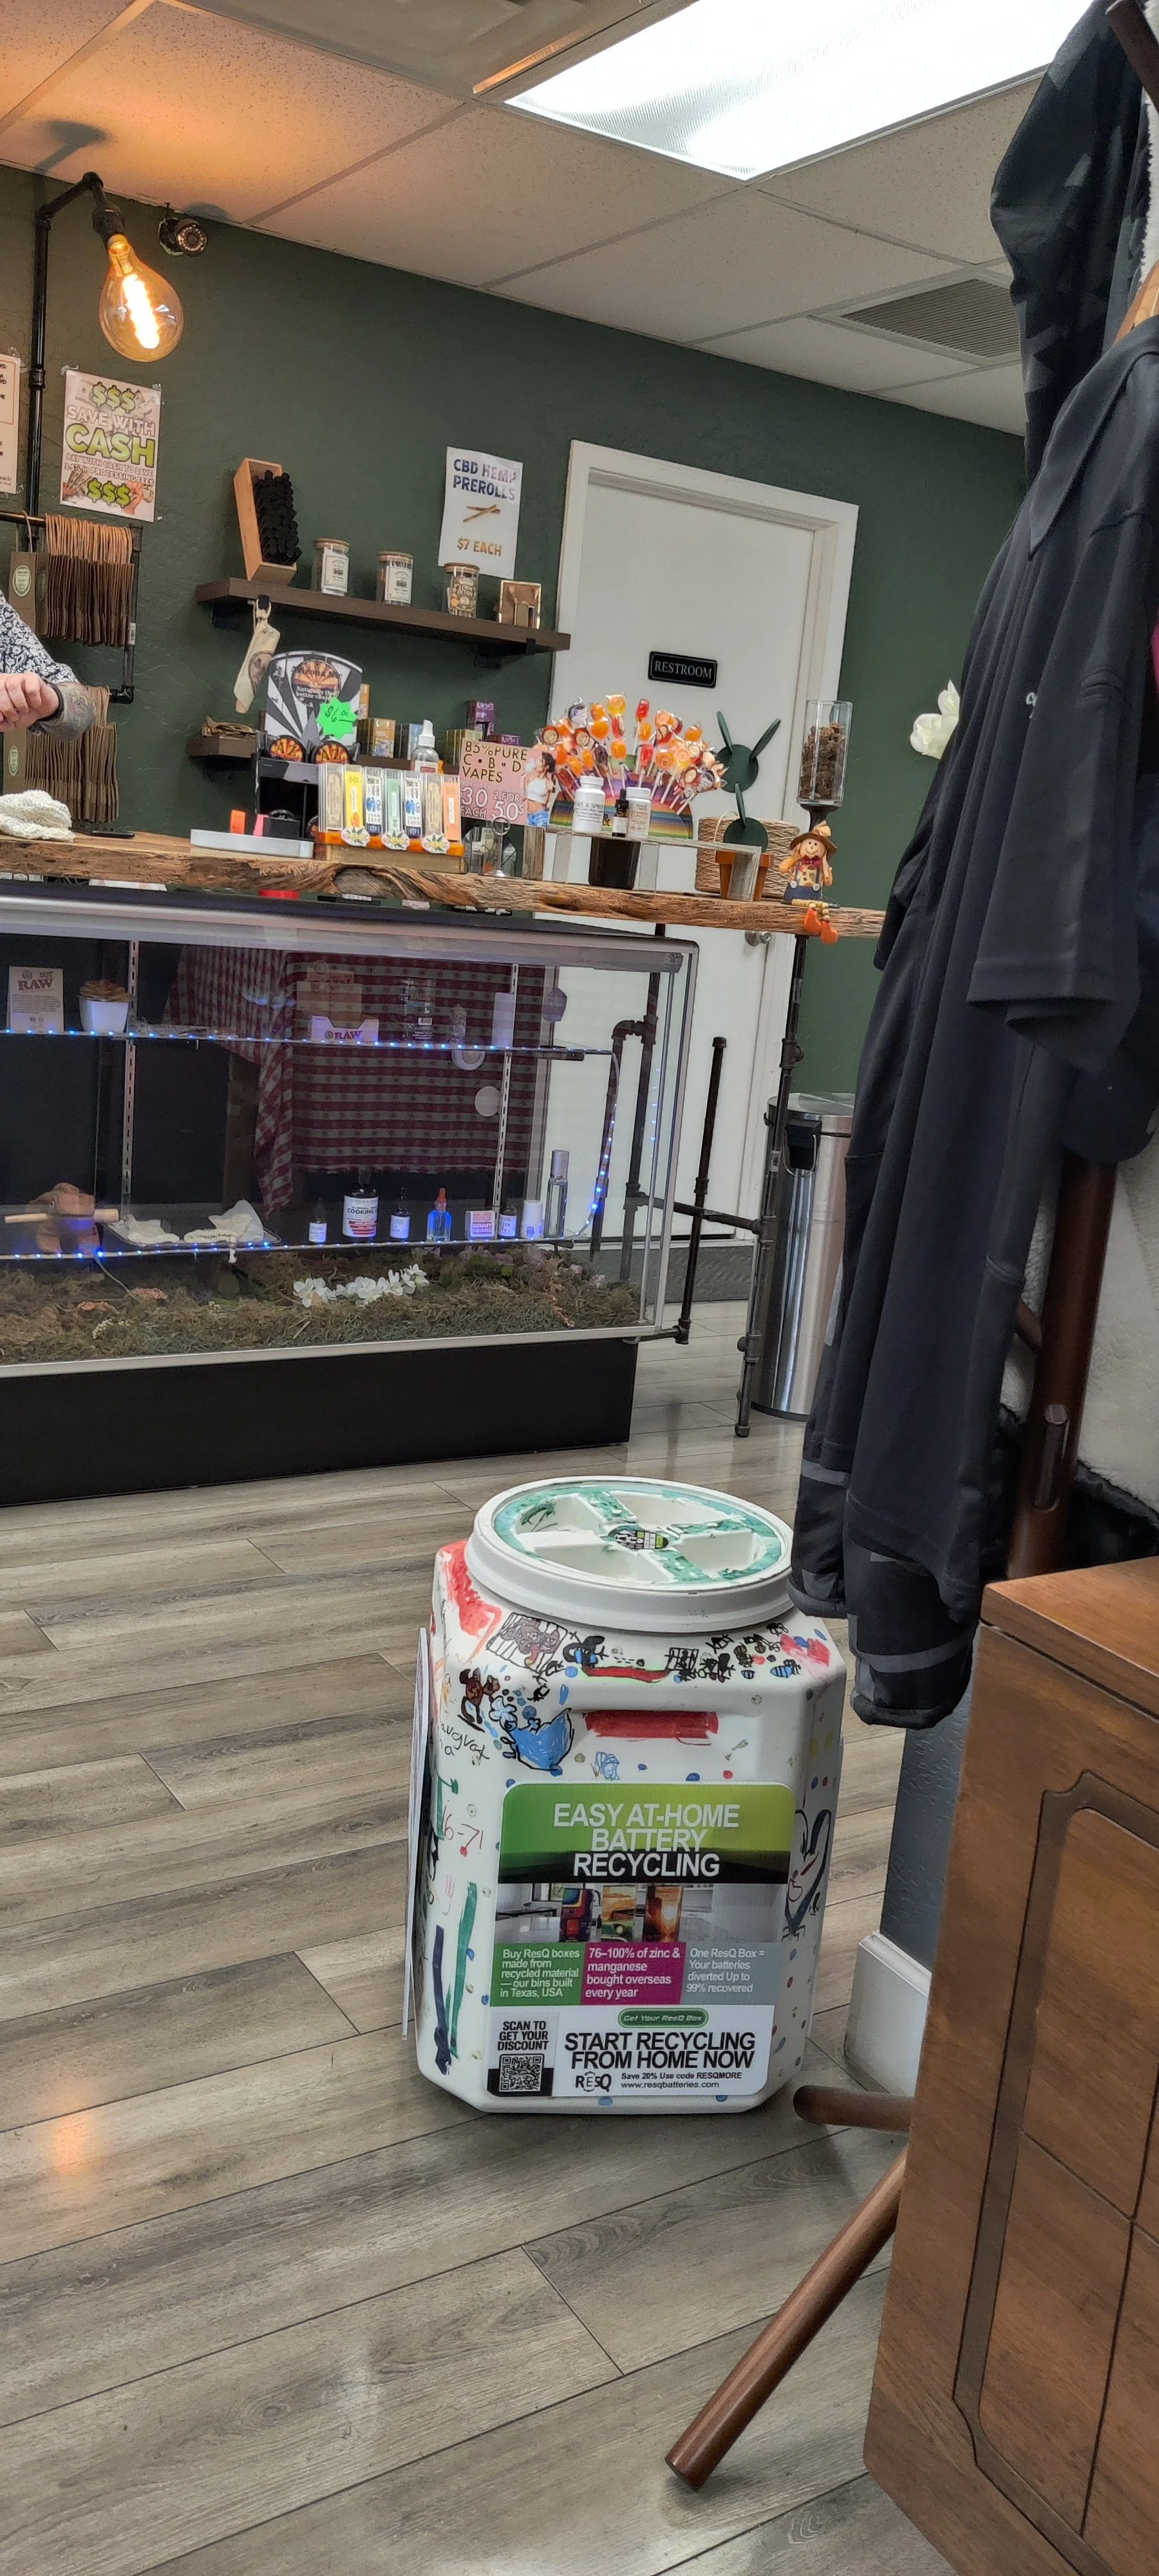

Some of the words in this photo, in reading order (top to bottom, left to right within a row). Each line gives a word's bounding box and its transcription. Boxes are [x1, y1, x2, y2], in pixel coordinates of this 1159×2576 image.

[92, 382, 135, 413] $$$
[66, 405, 108, 426] SAVE
[112, 414, 155, 437] WITH
[66, 423, 155, 468] CASH
[66, 453, 81, 462] PAY
[80, 456, 102, 467] WITH
[103, 460, 125, 471] CASH
[134, 467, 153, 477] SAVE
[90, 467, 137, 482] PROCESSING
[137, 477, 154, 486] FEES
[453, 459, 478, 475] CBD
[482, 464, 517, 484] HEMP
[87, 478, 131, 508] $$$
[453, 475, 515, 501] PREROLLS
[457, 536, 470, 550] $7
[473, 541, 502, 556] EACH
[655, 660, 712, 679] RESTROOM
[278, 739, 296, 757] AZ
[322, 748, 341, 761] AZ
[462, 766, 502, 782] VAPES
[493, 791, 499, 800] 2
[502, 792, 520, 802] FOR
[460, 806, 487, 818] EACH
[17, 979, 53, 990] RAW
[335, 1031, 362, 1039] RAW
[553, 1803, 624, 1828] EASY
[626, 1803, 740, 1828] AT-HOME
[592, 1828, 708, 1852] BATTERY
[572, 1853, 720, 1877] RECYCLING
[503, 1949, 522, 1960] Buy
[523, 1949, 549, 1958] ResQ
[552, 1949, 580, 1958] boxes
[637, 1948, 647, 1958] of
[649, 1947, 670, 1958] zinc
[672, 1947, 681, 1958] &
[690, 1948, 708, 1958] One
[711, 1948, 737, 1958] ResQ
[738, 1948, 757, 1958] Box
[502, 1960, 527, 1968] made
[530, 1959, 552, 1968] from
[587, 1962, 647, 1973] manganese
[689, 1960, 710, 1969] Your
[711, 1960, 751, 1969] batteries
[501, 1969, 540, 1980] recycled
[542, 1967, 579, 1978] material
[688, 1972, 724, 1982] diverted
[726, 1972, 739, 1983] Up
[740, 1973, 750, 1982] to
[531, 1978, 550, 1987] bins
[552, 1978, 572, 1987] built
[587, 1975, 623, 1987] bought
[625, 1975, 672, 1985] overseas
[500, 1989, 508, 1997] in
[511, 1988, 540, 1998] Texas,
[542, 1988, 563, 1997] USA
[585, 1989, 614, 2000] every
[614, 1989, 639, 2000] year
[686, 1984, 706, 1993] 99%
[708, 1984, 753, 1993] recovered
[503, 2021, 531, 2031] SCAN
[533, 2020, 547, 2030] TO
[499, 2031, 519, 2041] GET
[522, 2031, 549, 2041] YOUR
[564, 2032, 633, 2051] START
[636, 2032, 755, 2051] RECYCLING
[498, 2041, 549, 2051] DISCOUNT
[571, 2051, 632, 2069] FROM
[636, 2050, 699, 2069] HOME
[702, 2050, 755, 2069] NOW
